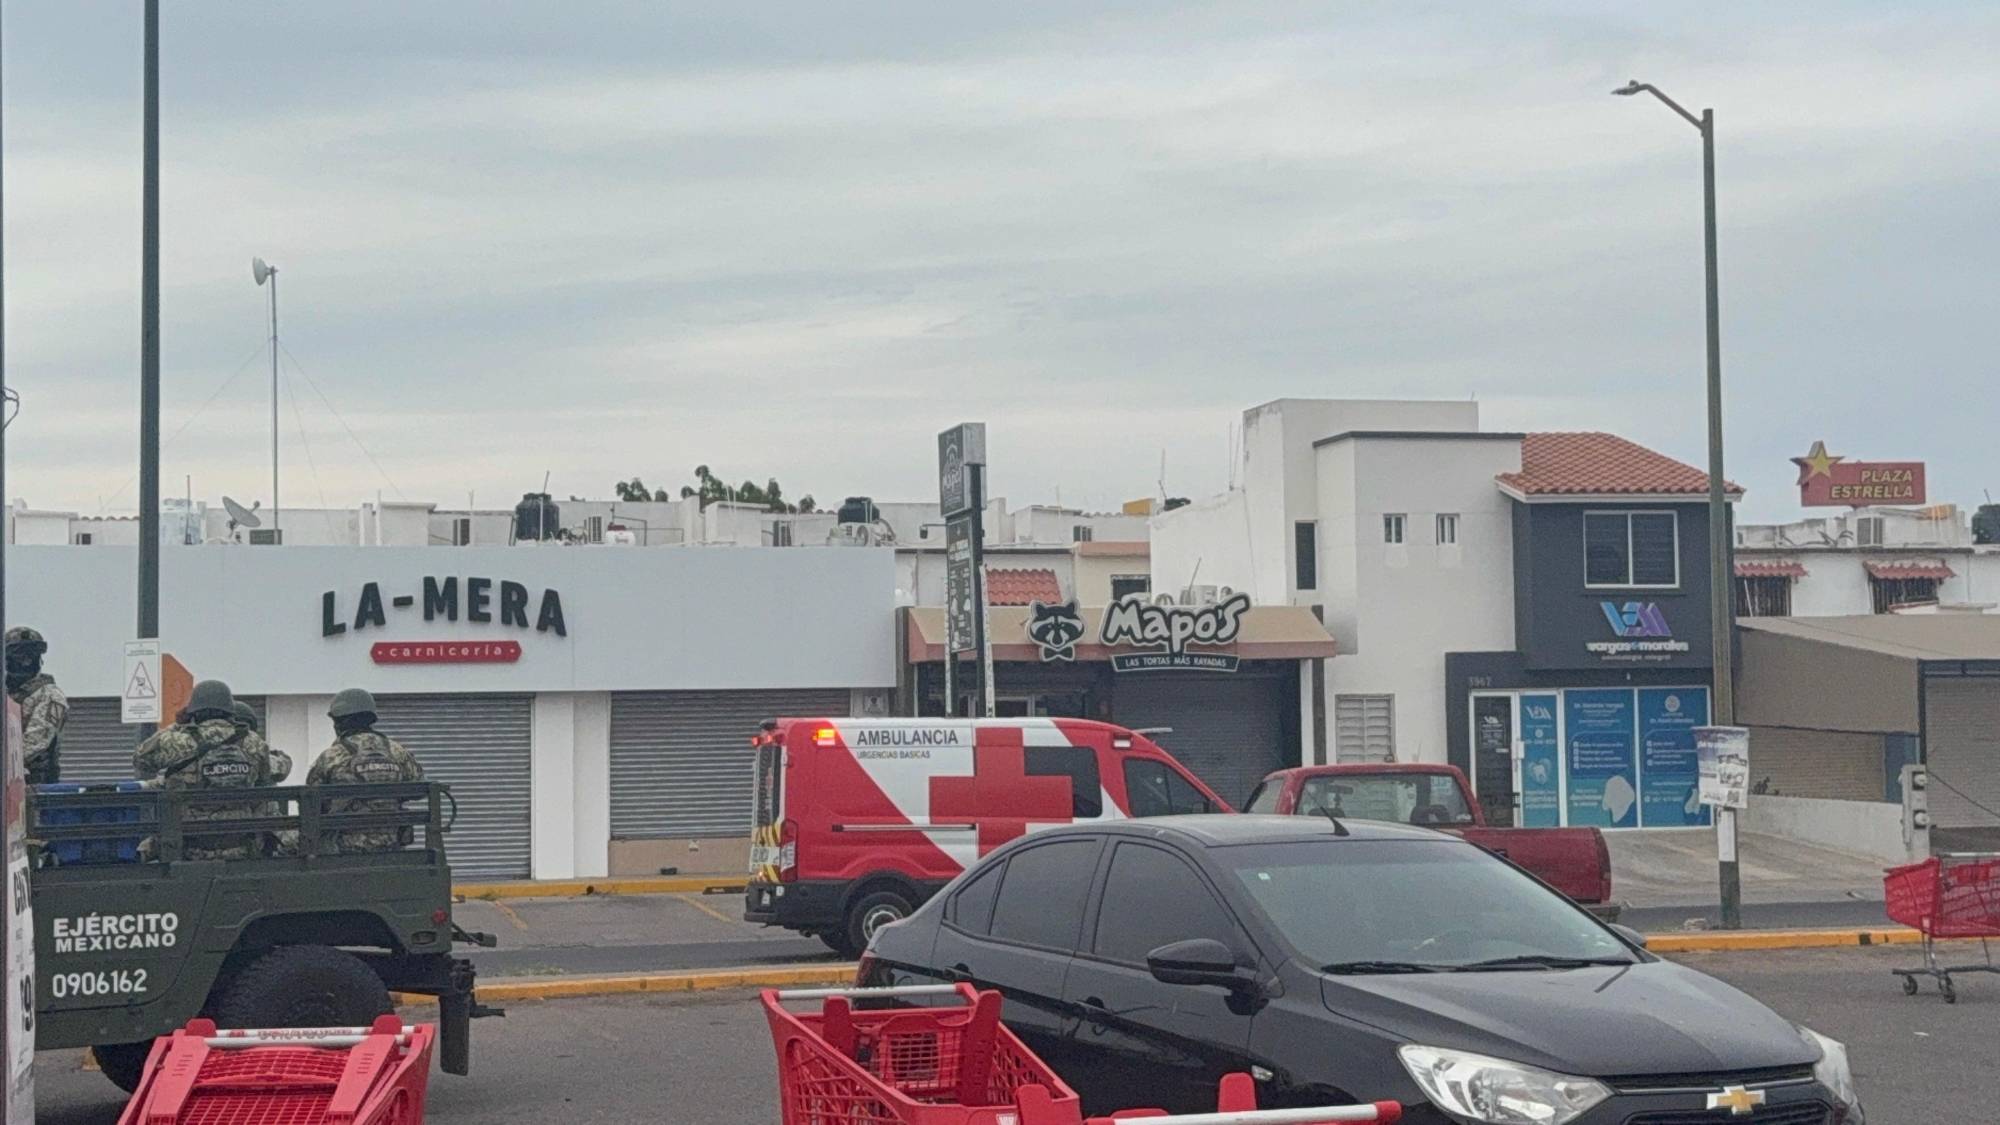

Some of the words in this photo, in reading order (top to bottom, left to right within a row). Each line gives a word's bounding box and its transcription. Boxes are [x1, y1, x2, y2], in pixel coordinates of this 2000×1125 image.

[1861, 469, 1913, 482] PLAZA
[1831, 486, 1913, 498] ESTRELLA
[322, 576, 567, 637] LA-MERA
[1103, 595, 1248, 654] Mapo's
[389, 643, 502, 658] carnicería
[1125, 658, 1139, 667] LAS
[1143, 657, 1170, 666] TORTAS
[1173, 655, 1188, 665] MÁS
[1193, 656, 1227, 667] RAYADAS
[857, 729, 959, 745] AMBULANCIA
[857, 750, 898, 759] URGENCIAS
[53, 911, 179, 938] EJÉRCITO
[55, 932, 177, 953] MEXICANO
[52, 968, 148, 998] 0906162
